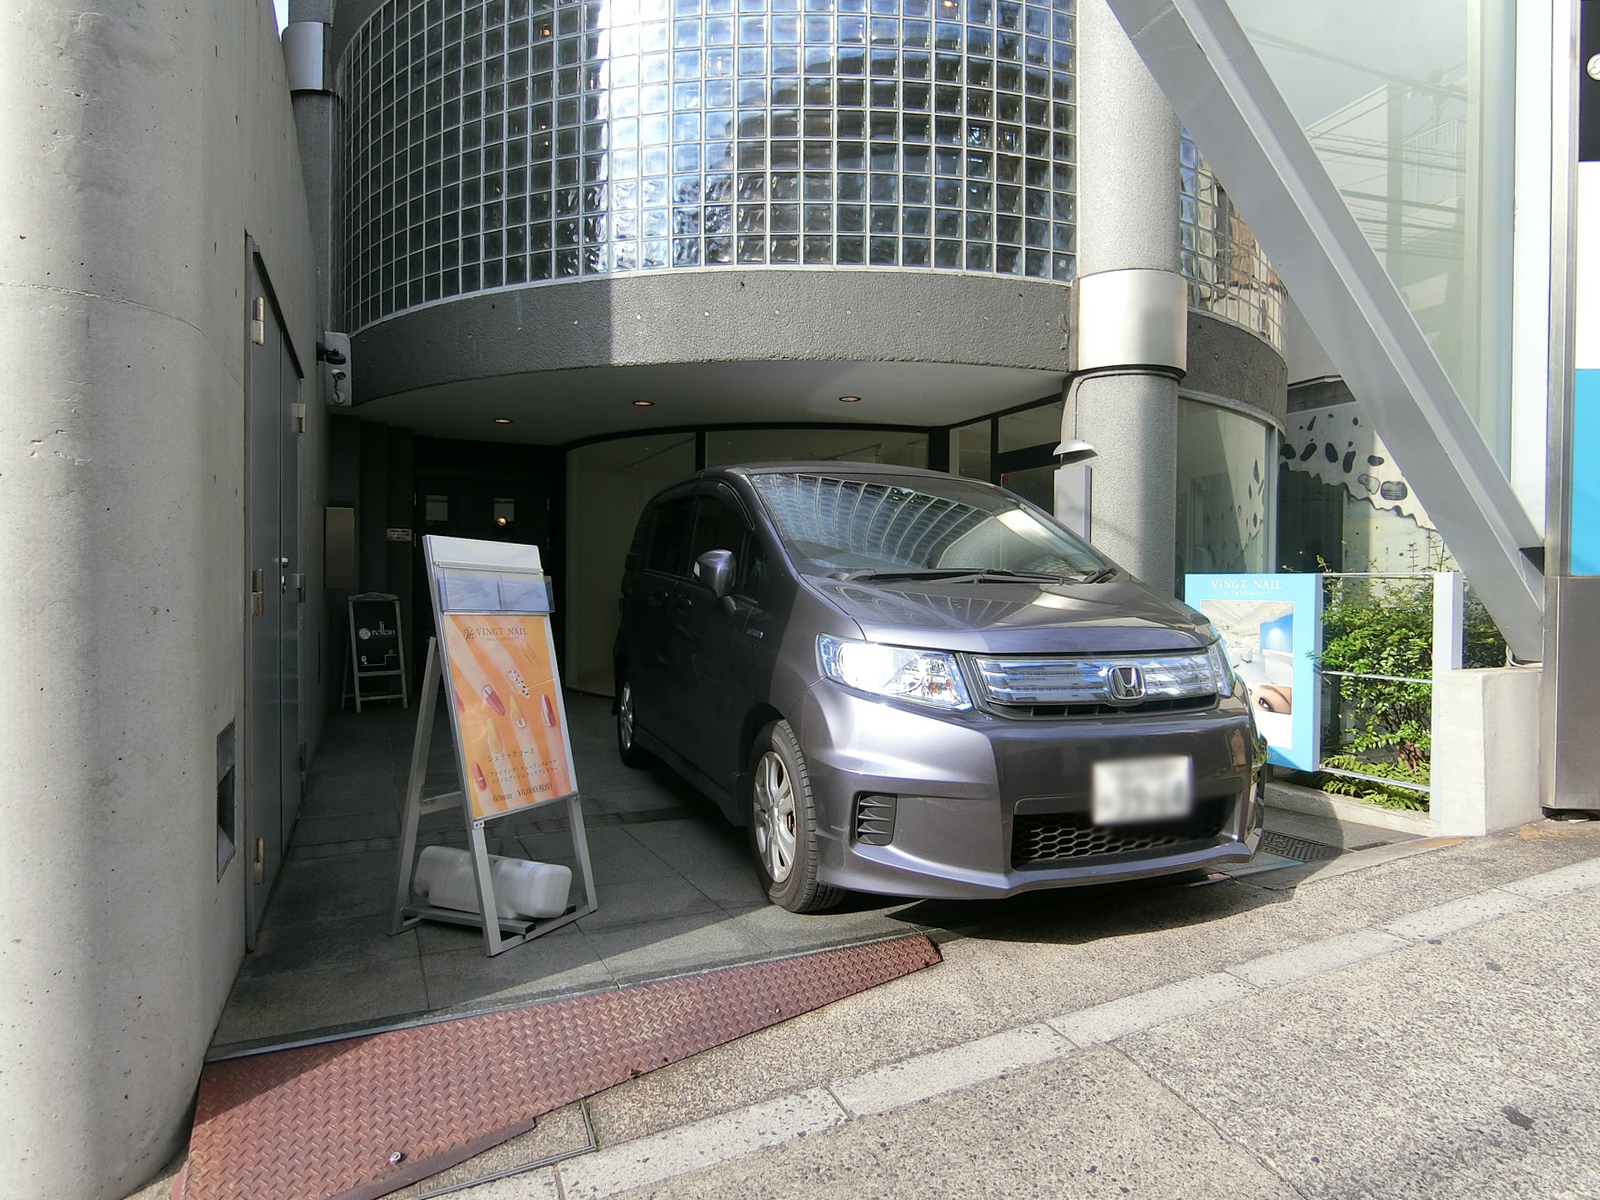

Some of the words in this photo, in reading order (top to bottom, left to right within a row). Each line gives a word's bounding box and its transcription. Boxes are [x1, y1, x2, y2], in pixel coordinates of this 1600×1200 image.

[1211, 579, 1247, 590] VINGT
[1253, 579, 1283, 590] NAIL
[475, 627, 504, 636] VINGT
[507, 627, 528, 636] NAIL
